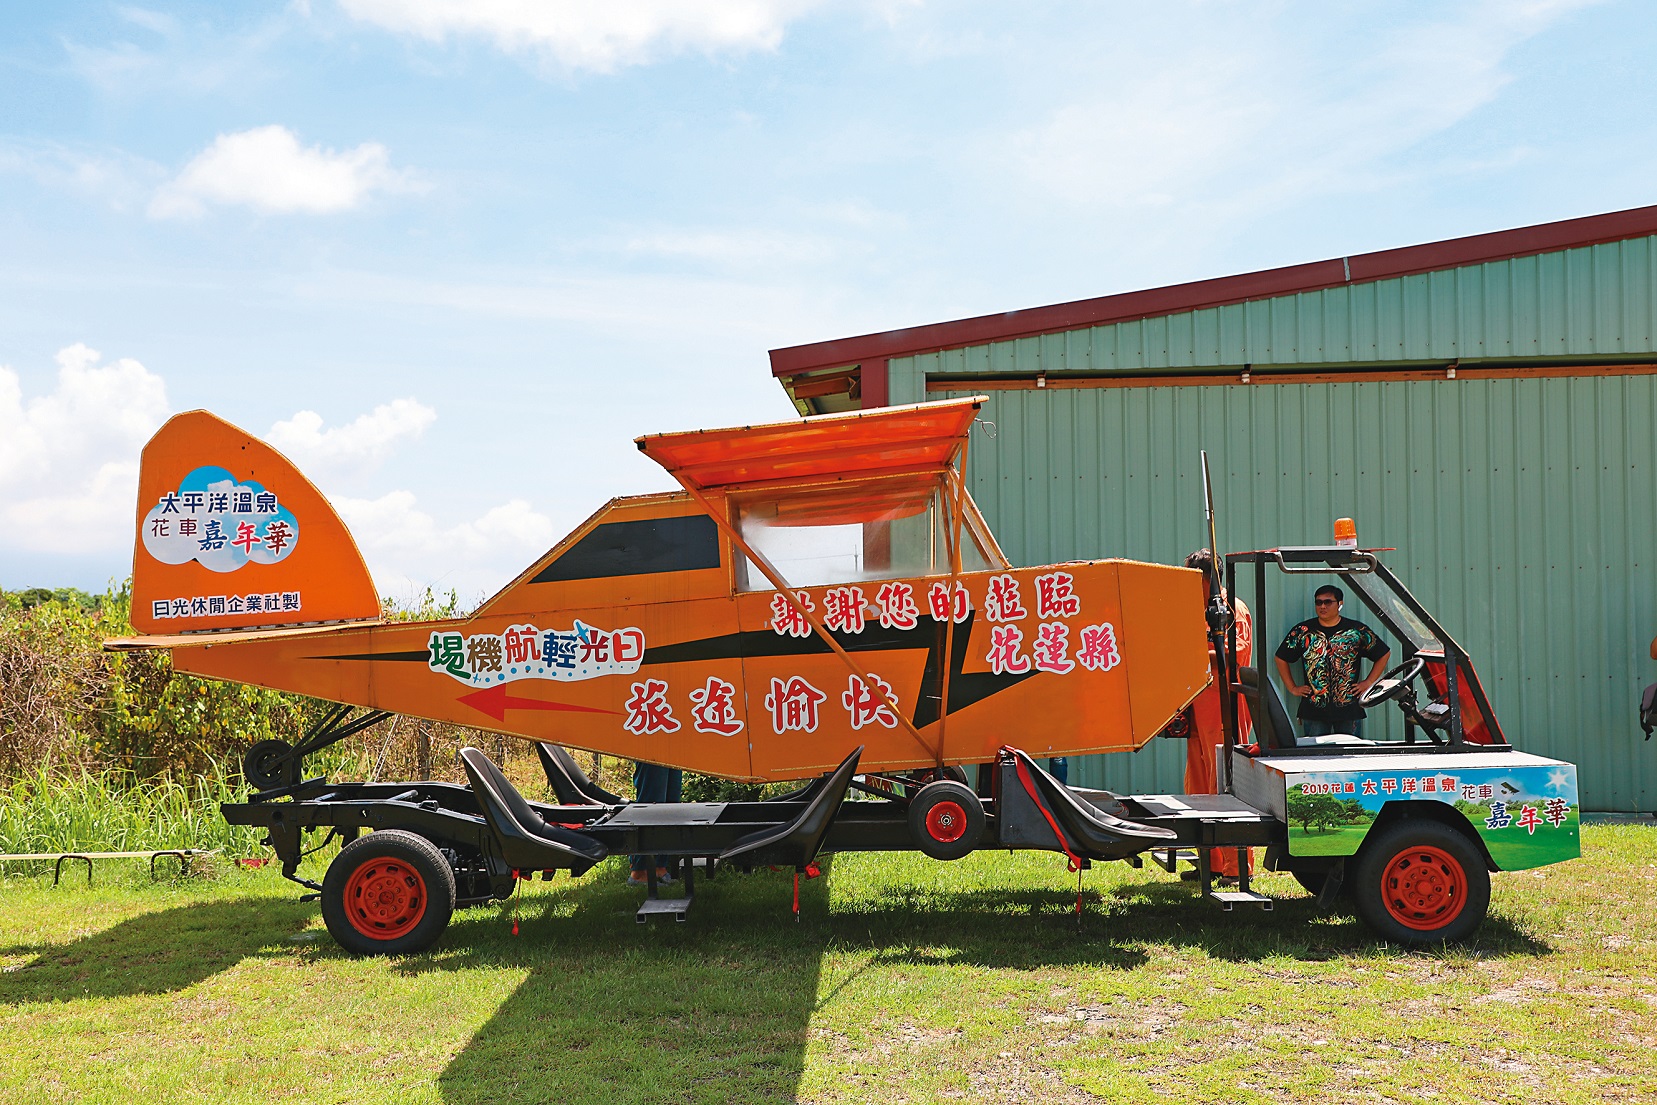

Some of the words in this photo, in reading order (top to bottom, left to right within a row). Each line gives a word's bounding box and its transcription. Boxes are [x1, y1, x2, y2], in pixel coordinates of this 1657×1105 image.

[160, 492, 278, 514] 太平洋溫泉
[153, 591, 301, 618] 日光休閒企業社製
[772, 574, 1078, 636] 謝謝您的蒞臨
[988, 625, 1119, 673] 花蓮縣
[625, 677, 897, 735] 旅途愉快
[1361, 777, 1457, 795] 太平洋溫泉
